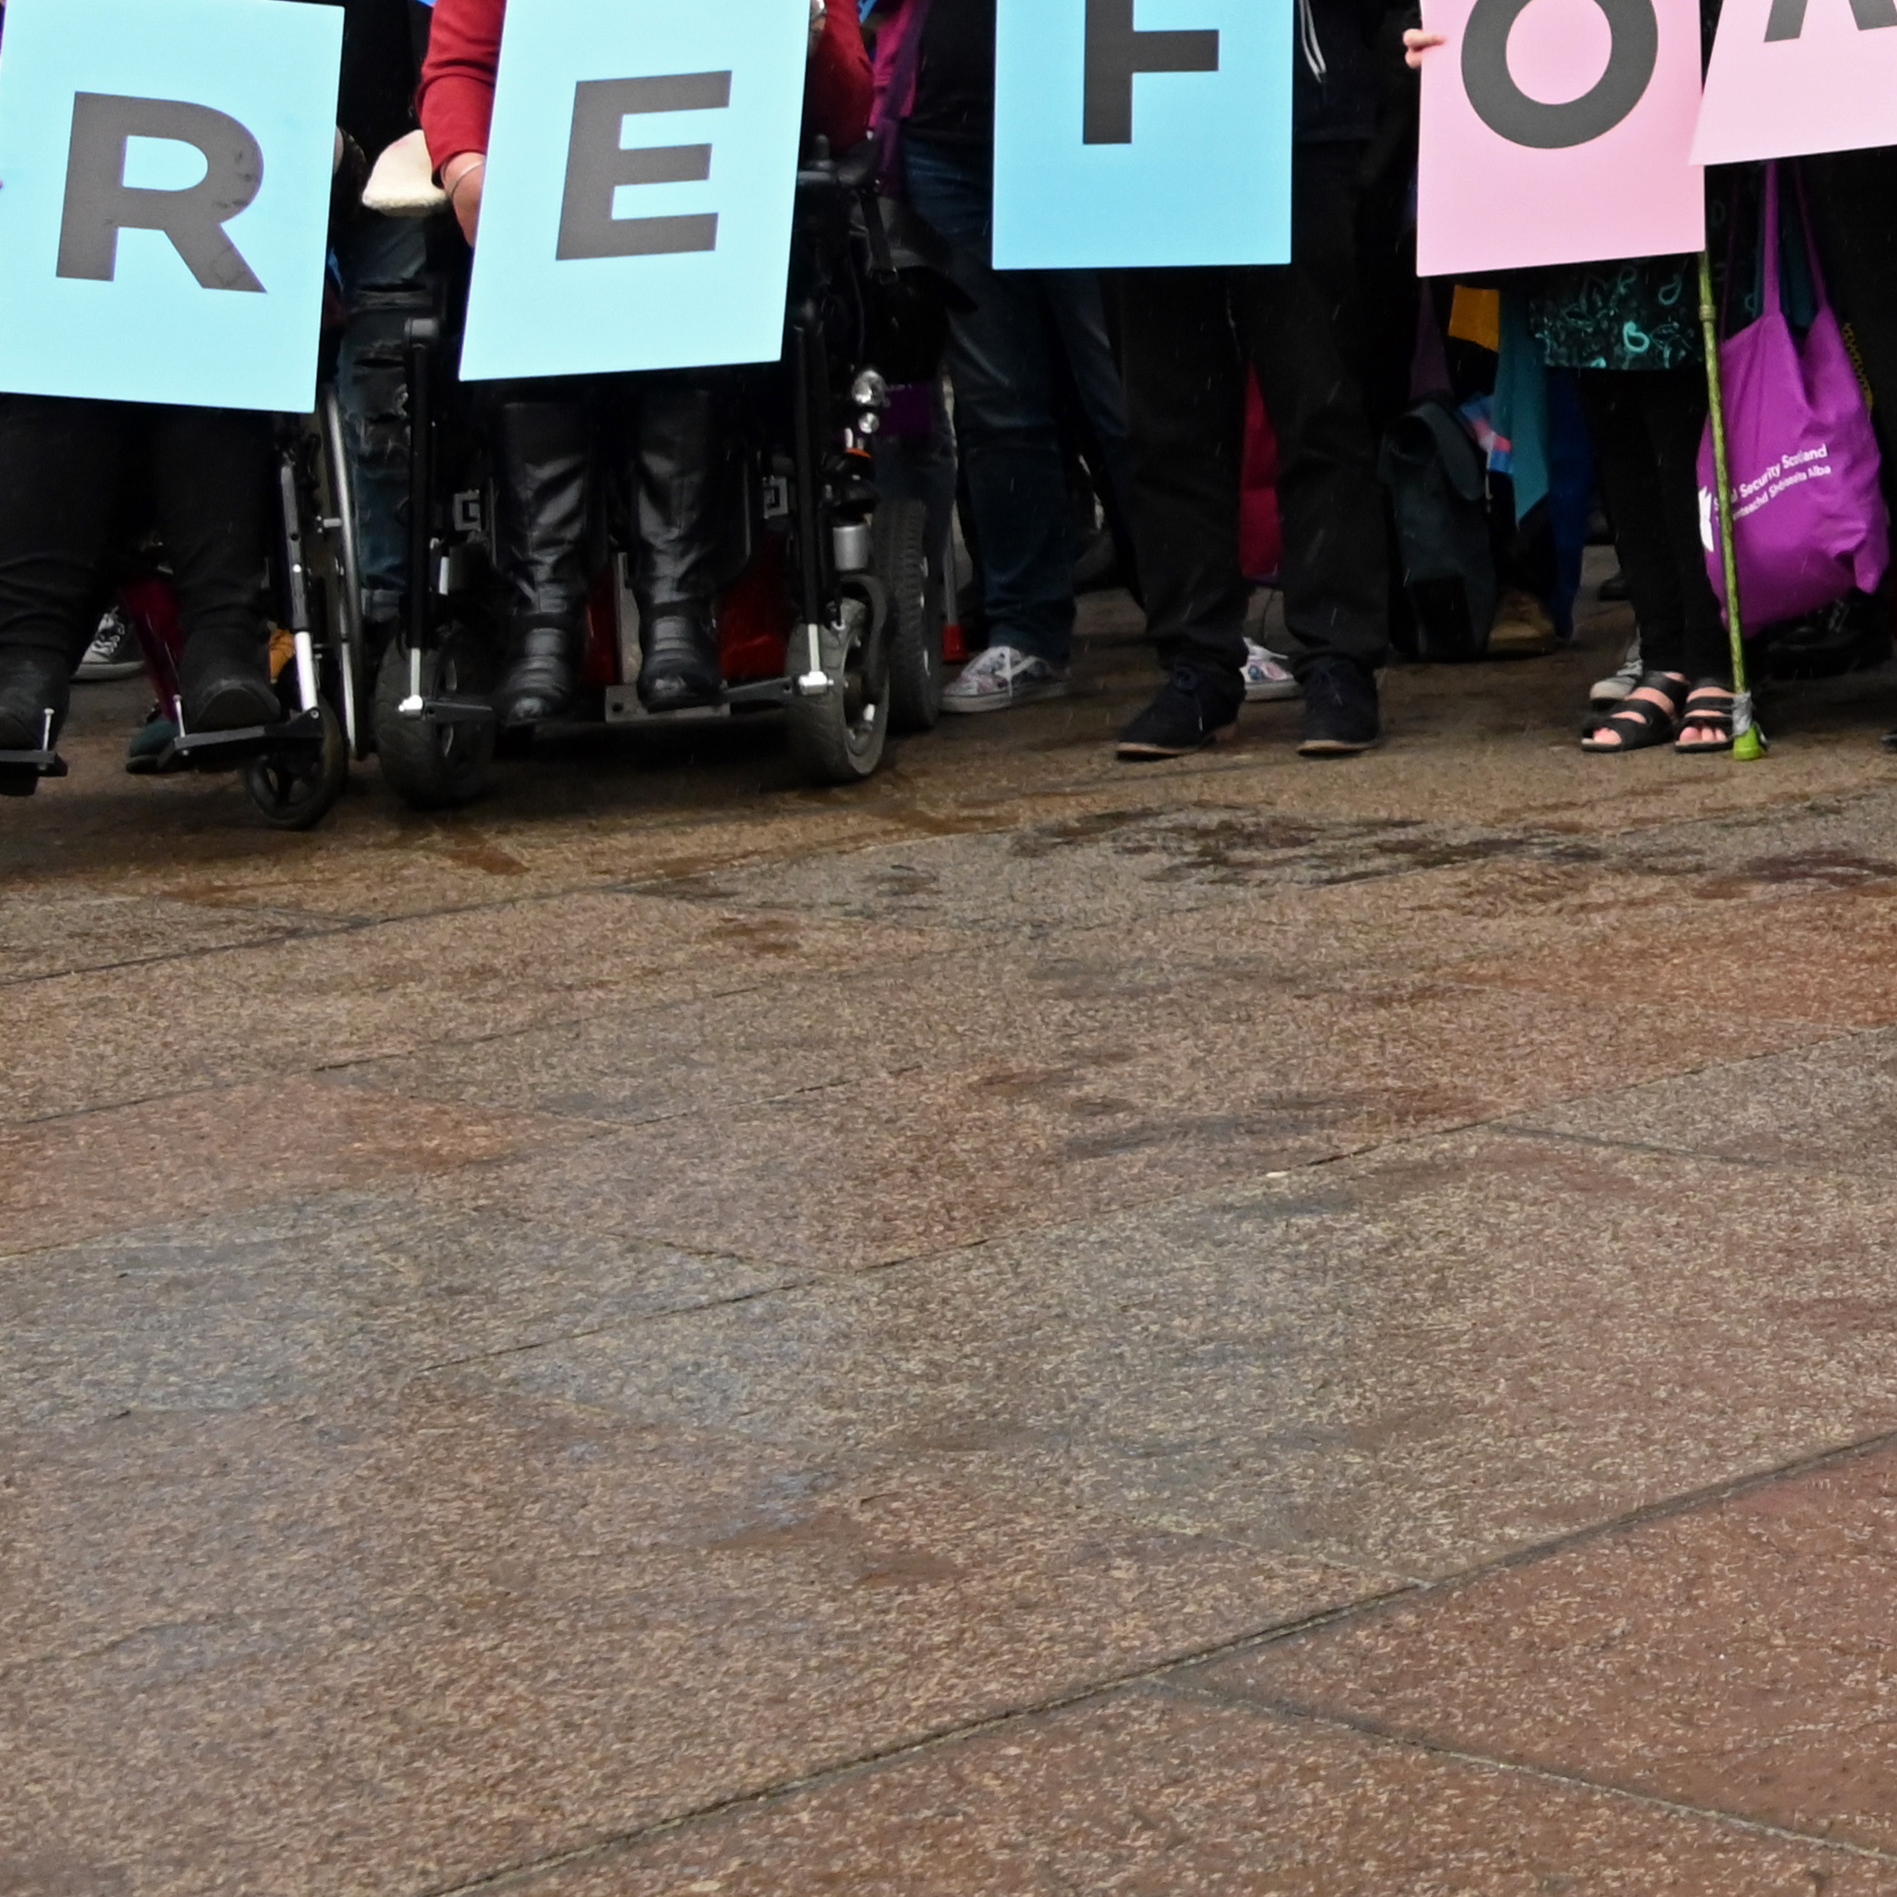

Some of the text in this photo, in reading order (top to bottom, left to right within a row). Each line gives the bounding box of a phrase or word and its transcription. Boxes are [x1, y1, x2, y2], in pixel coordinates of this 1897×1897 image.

[56, 91, 267, 293] R
[556, 70, 732, 261] E
[1740, 463, 1781, 498] Security
